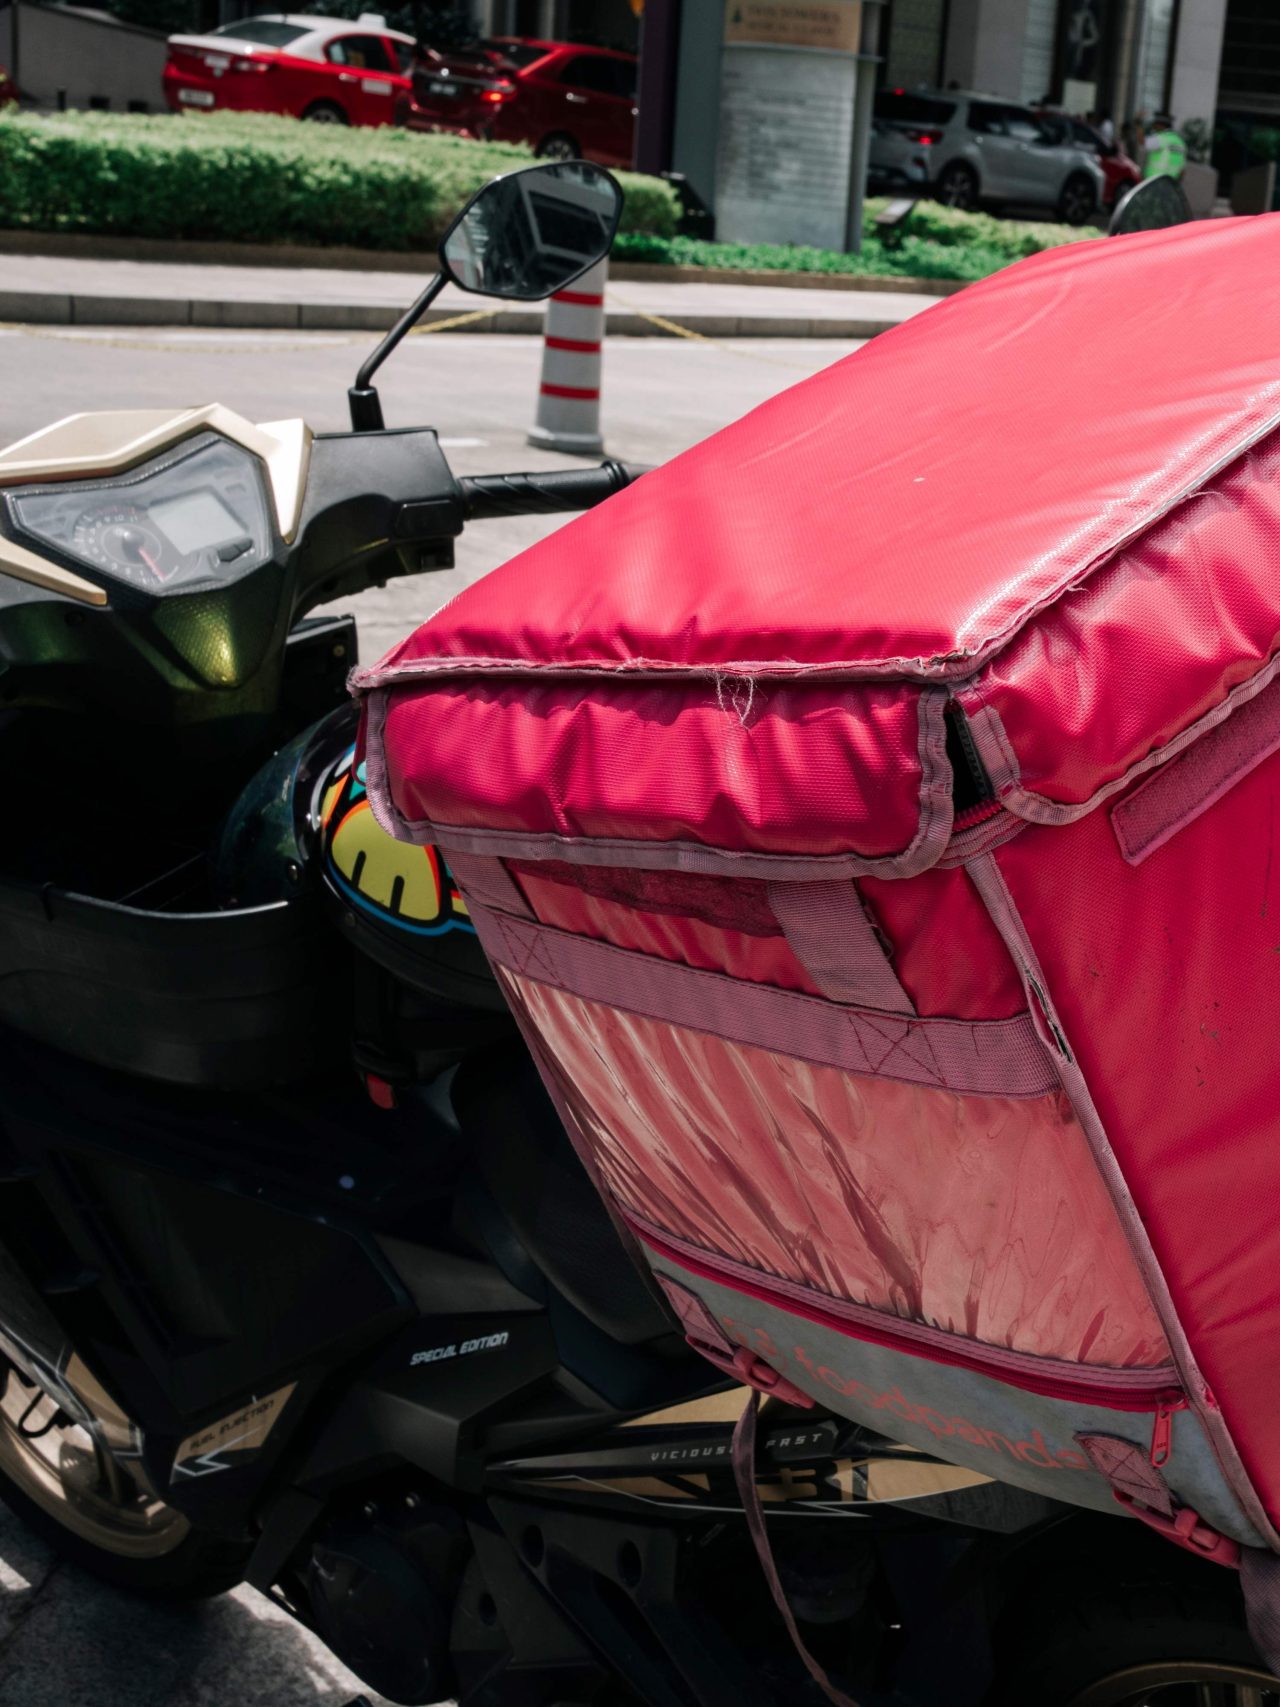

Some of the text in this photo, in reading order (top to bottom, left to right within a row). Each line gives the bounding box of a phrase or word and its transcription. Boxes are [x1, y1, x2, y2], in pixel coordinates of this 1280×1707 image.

[410, 1332, 509, 1366] SPECIAL EDITION
[651, 1432, 823, 1462] VICIOUS FAST
